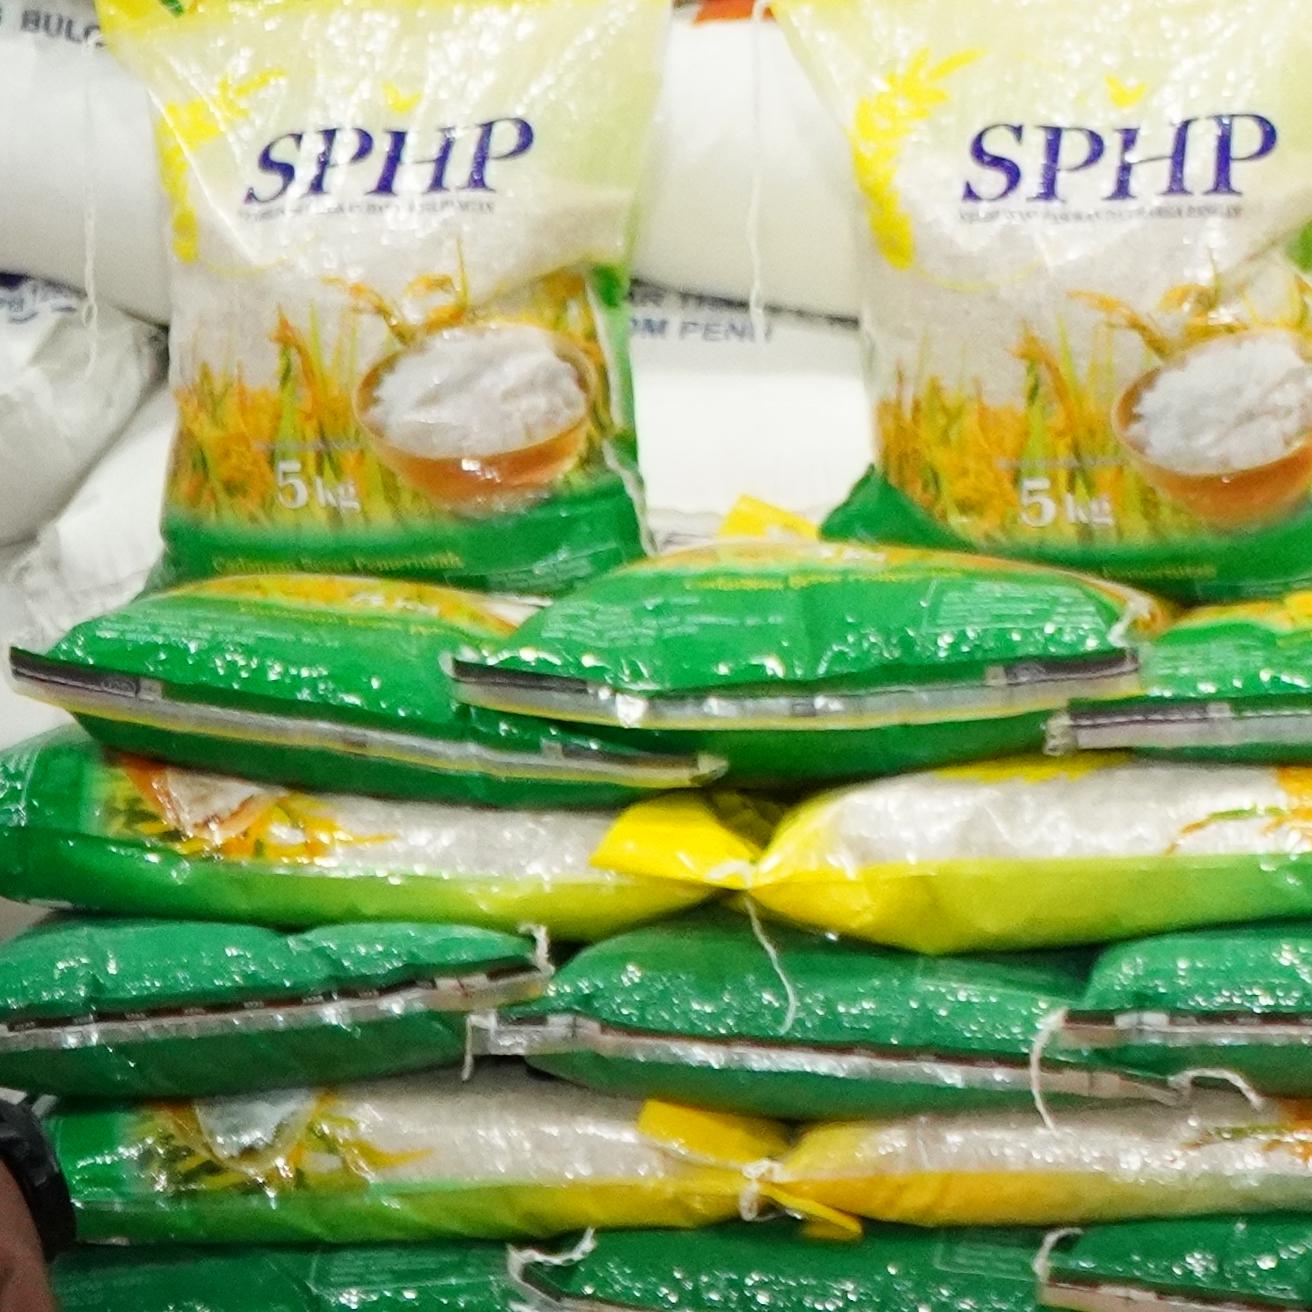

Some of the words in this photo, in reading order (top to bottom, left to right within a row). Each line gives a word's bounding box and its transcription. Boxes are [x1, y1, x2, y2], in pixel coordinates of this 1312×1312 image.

[242, 116, 535, 205] SPHP
[960, 112, 1279, 204] SPHP
[276, 459, 309, 510] 5
[1020, 476, 1057, 529] 5
